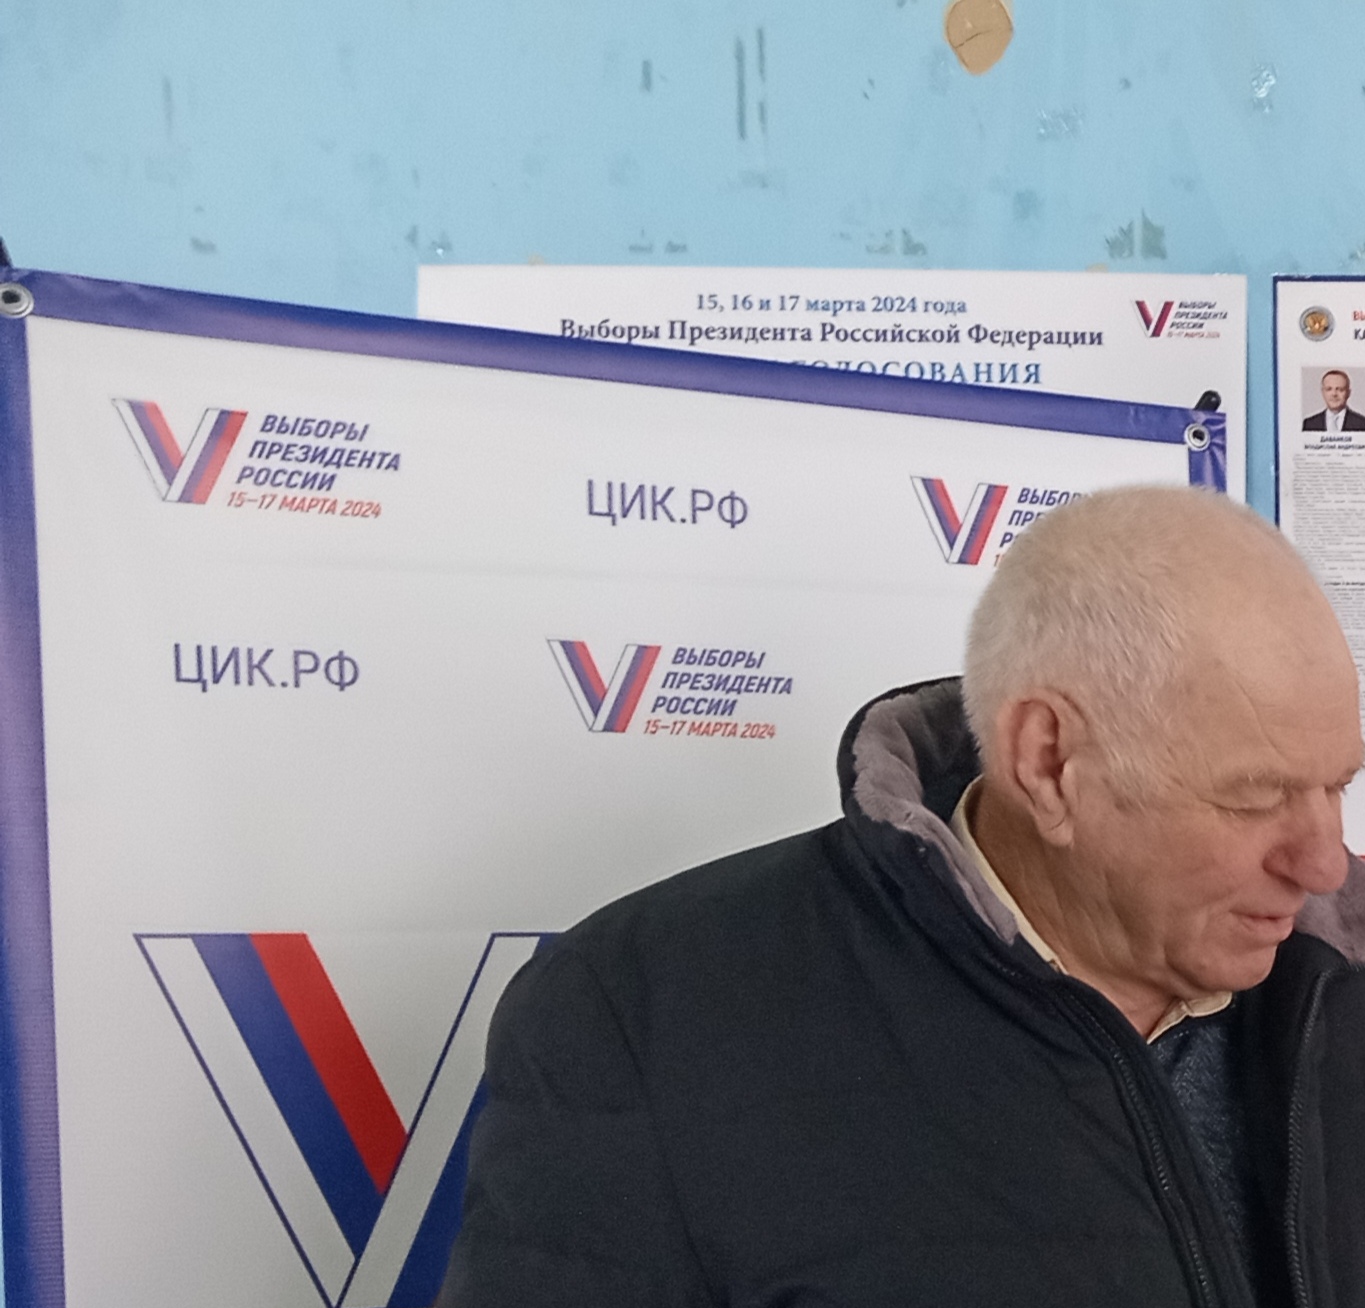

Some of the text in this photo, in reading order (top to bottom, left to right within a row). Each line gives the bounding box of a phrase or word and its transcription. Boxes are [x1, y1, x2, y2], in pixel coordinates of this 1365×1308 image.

[697, 294, 967, 316] 15, 16 и 17 марта 2024 года
[560, 318, 1103, 350] Выборы Президента Российской Федерации
[259, 413, 370, 443] ВЫБОРЫ
[248, 439, 402, 472] ПРЕЗИДЕНТА
[235, 465, 337, 492] РОССИИ
[278, 495, 338, 516] МАРТА
[339, 499, 382, 519] 2024
[586, 478, 749, 529] ЦИК.РФ
[173, 641, 360, 693] ЦИК.РФ
[671, 646, 766, 669] ВЫБОРЫ
[660, 671, 793, 695] ПРЕЗИДЕНТА
[650, 695, 738, 717] РОССИИ
[687, 721, 738, 738] МАРТА
[740, 723, 776, 740] 2024
